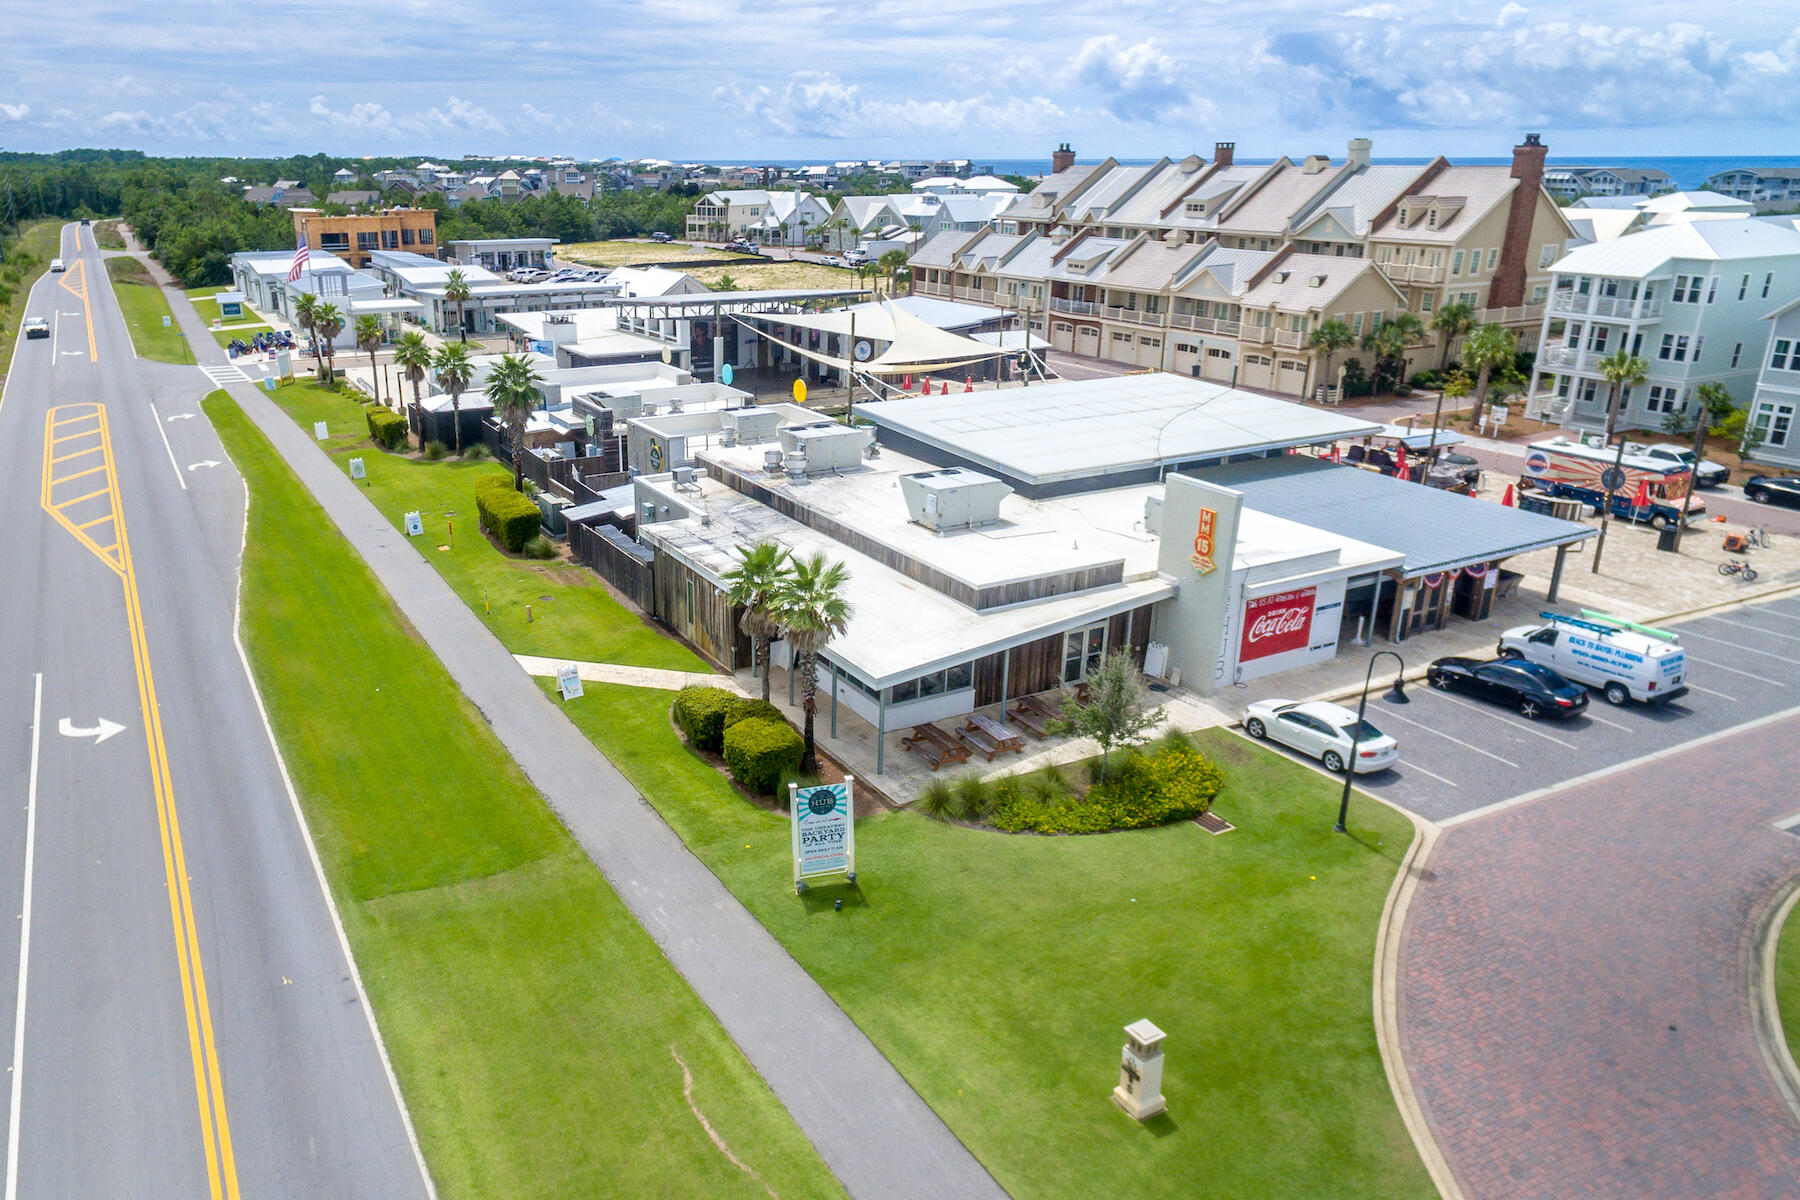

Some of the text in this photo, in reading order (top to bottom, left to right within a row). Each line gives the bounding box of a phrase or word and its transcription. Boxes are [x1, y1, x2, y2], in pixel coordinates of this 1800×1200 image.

[1196, 537, 1210, 554] 15
[1267, 608, 1287, 617] DRINK
[811, 797, 834, 807] HUB
[802, 827, 846, 837] BACKYARD
[802, 832, 846, 845] PARTY
